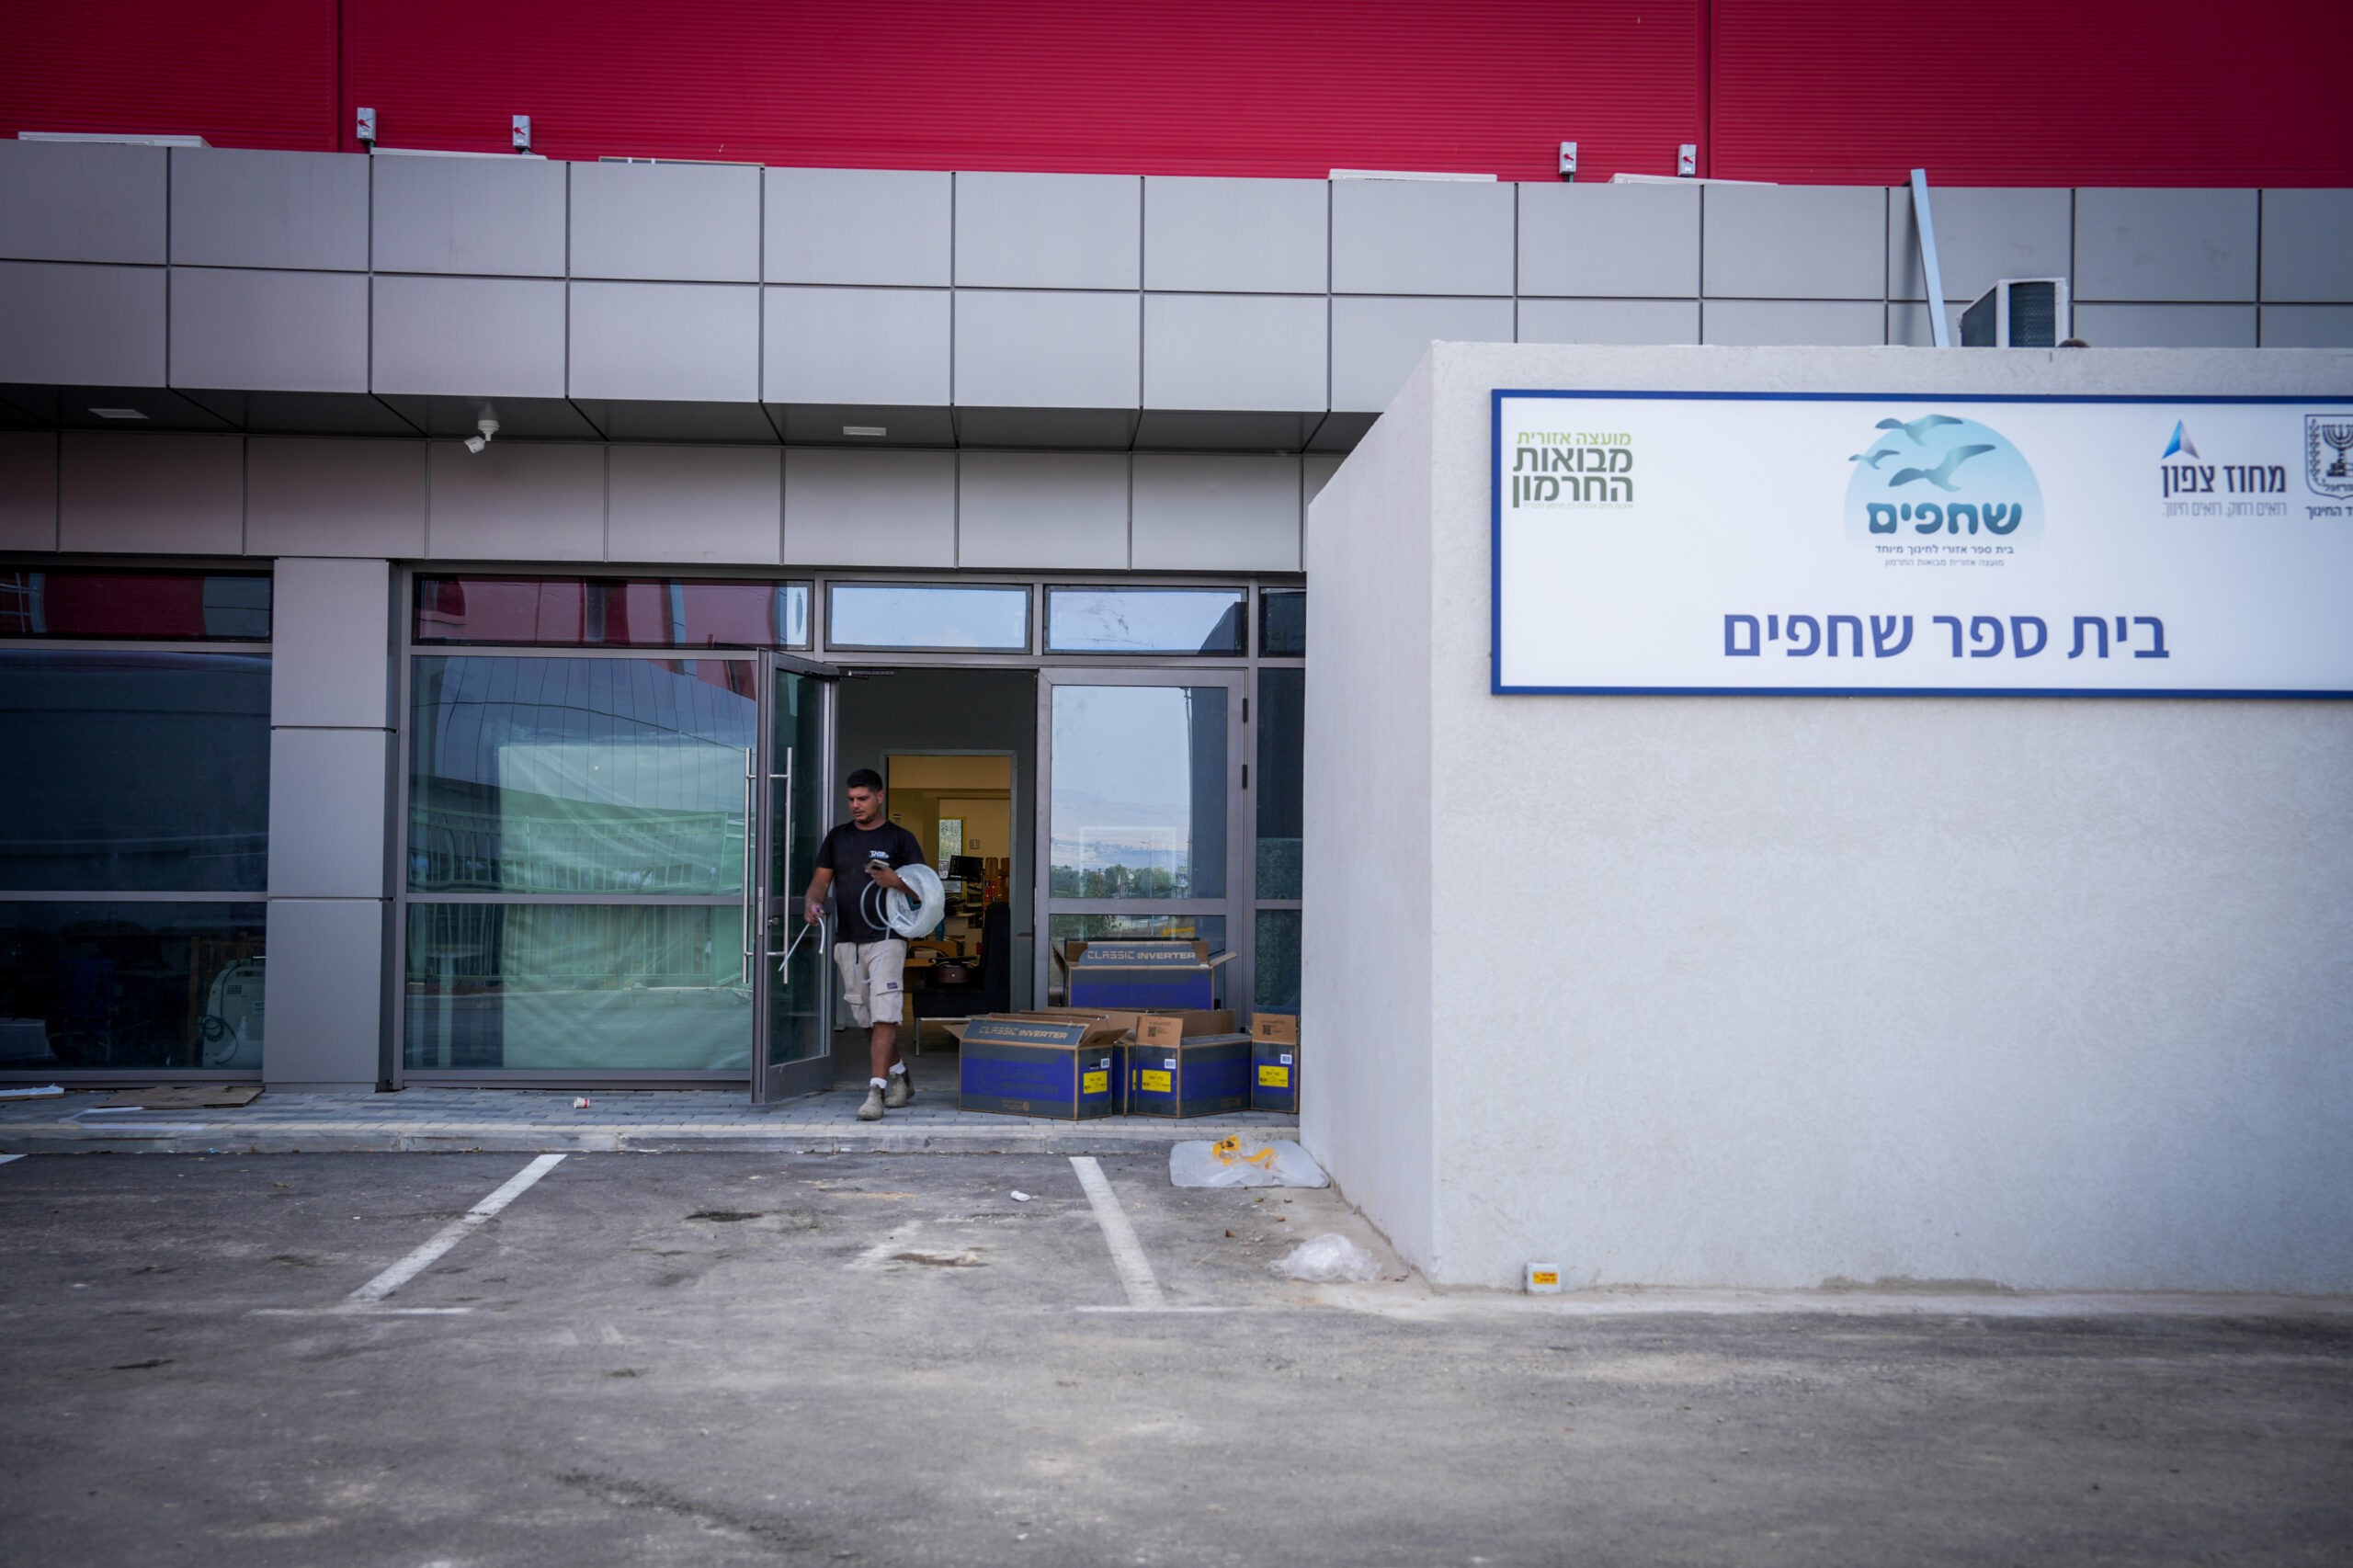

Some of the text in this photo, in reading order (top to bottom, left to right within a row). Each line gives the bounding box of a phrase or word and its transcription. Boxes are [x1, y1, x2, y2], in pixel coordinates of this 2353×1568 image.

[1517, 432, 1631, 446] מועצה אזורית
[1513, 448, 1633, 472] מבואות
[2161, 465, 2287, 498] מחוז צפון
[1513, 475, 1633, 508] החרמון
[1866, 502, 2022, 535] שחפים
[2304, 506, 2343, 521] החינוך
[1875, 543, 2015, 556] בית ספר אזורי לחינוך מיוחד
[1724, 614, 2169, 659] בית ספר שחפים
[1087, 950, 1196, 960] CLASSIC INVERTER
[978, 1026, 1068, 1040] CLASSIC INVERTER
